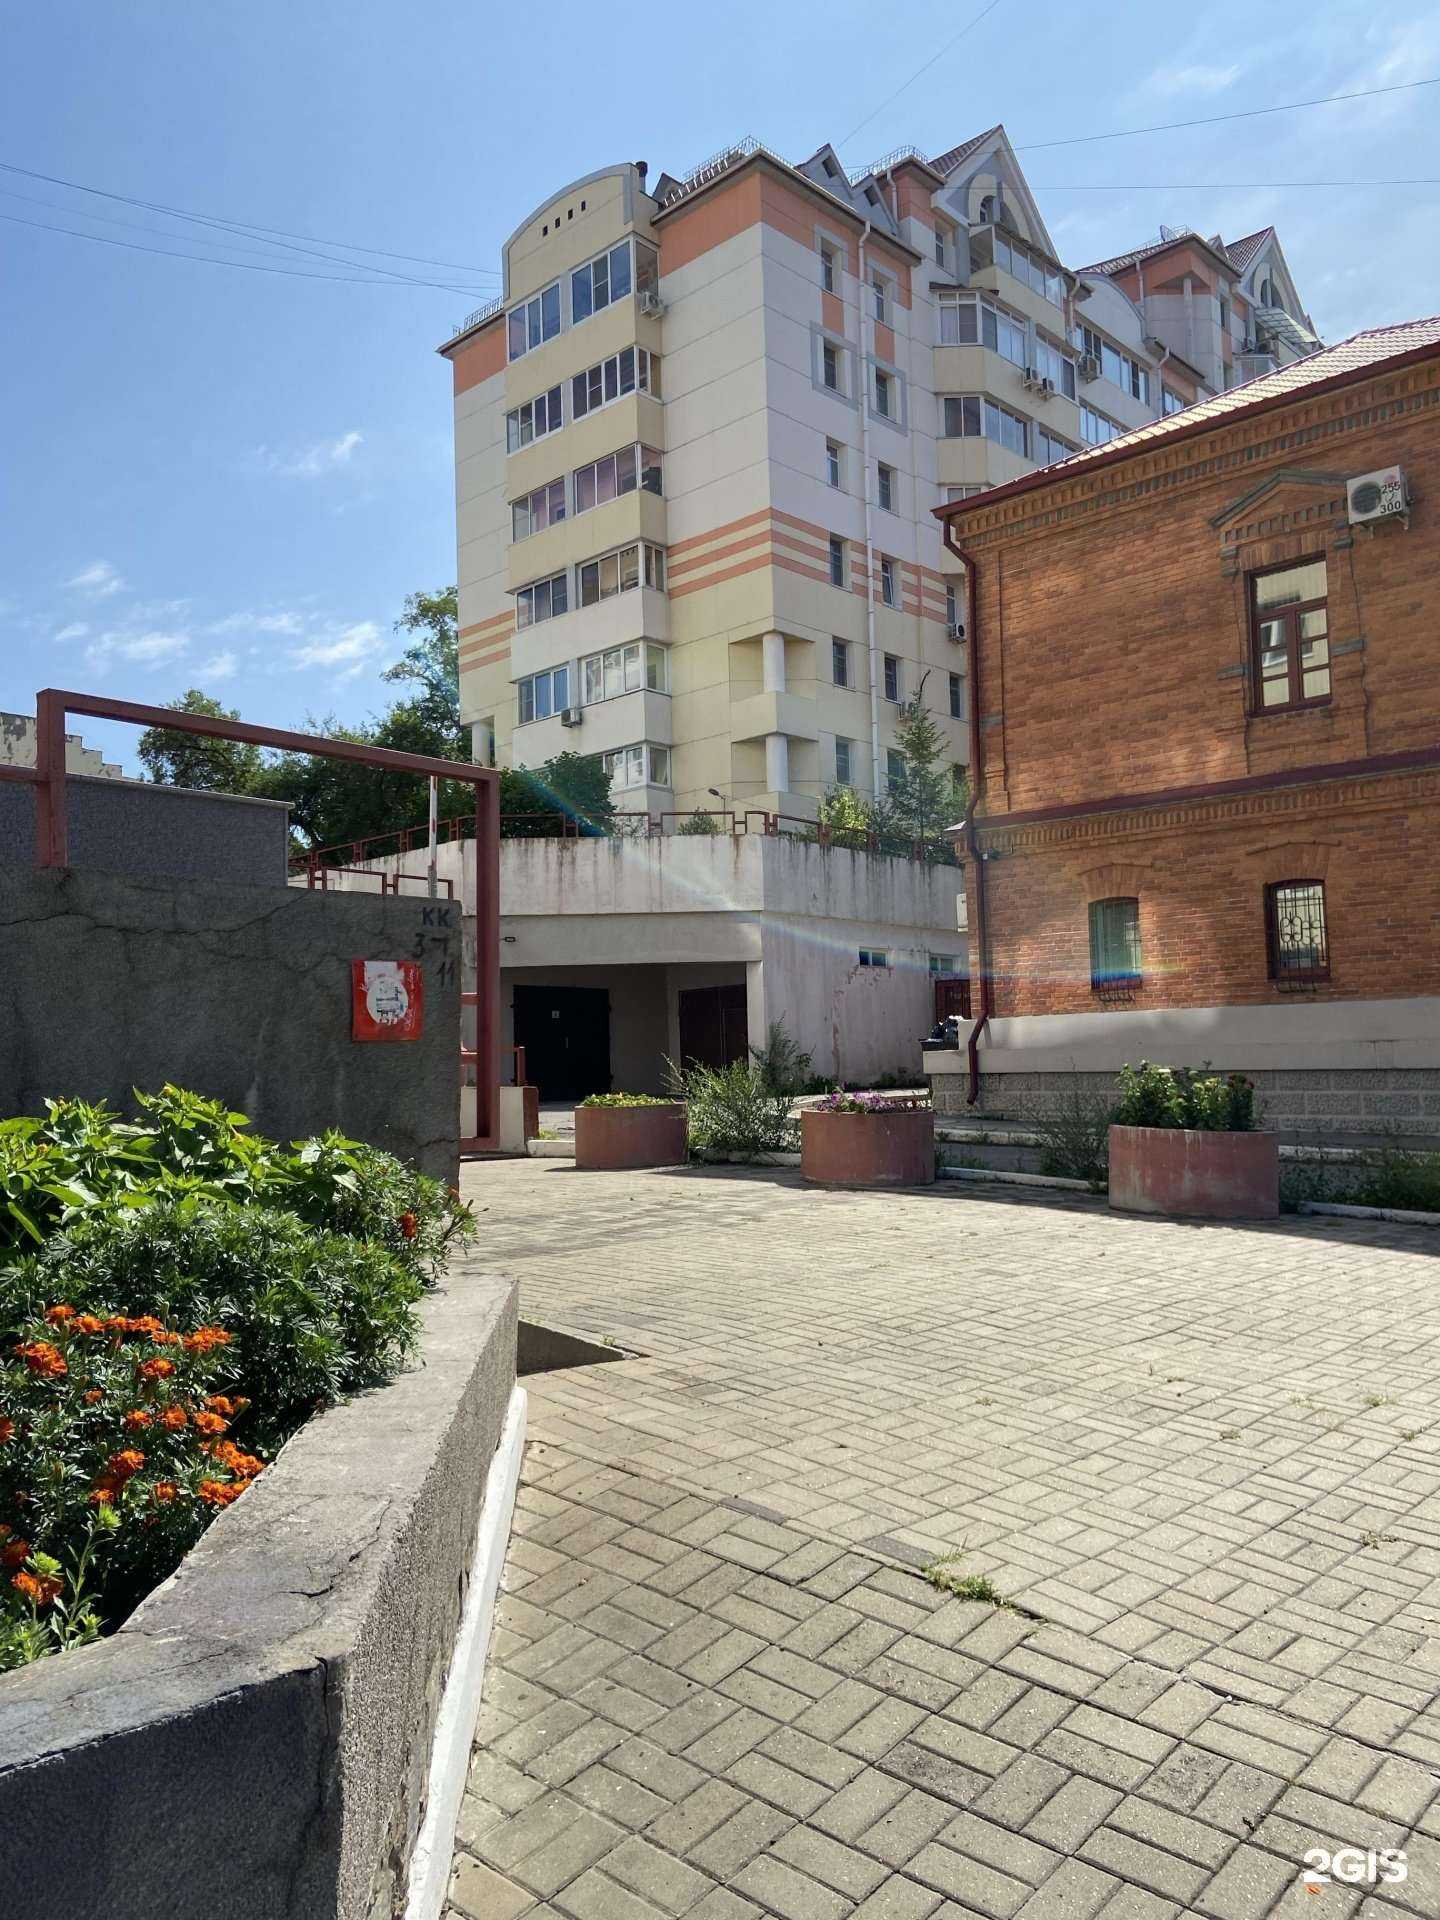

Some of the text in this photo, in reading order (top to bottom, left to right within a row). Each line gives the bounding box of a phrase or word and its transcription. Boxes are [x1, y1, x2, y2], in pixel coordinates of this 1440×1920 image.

[1382, 481, 1400, 494] 255
[1380, 501, 1401, 513] 300
[436, 961, 454, 987] 11
